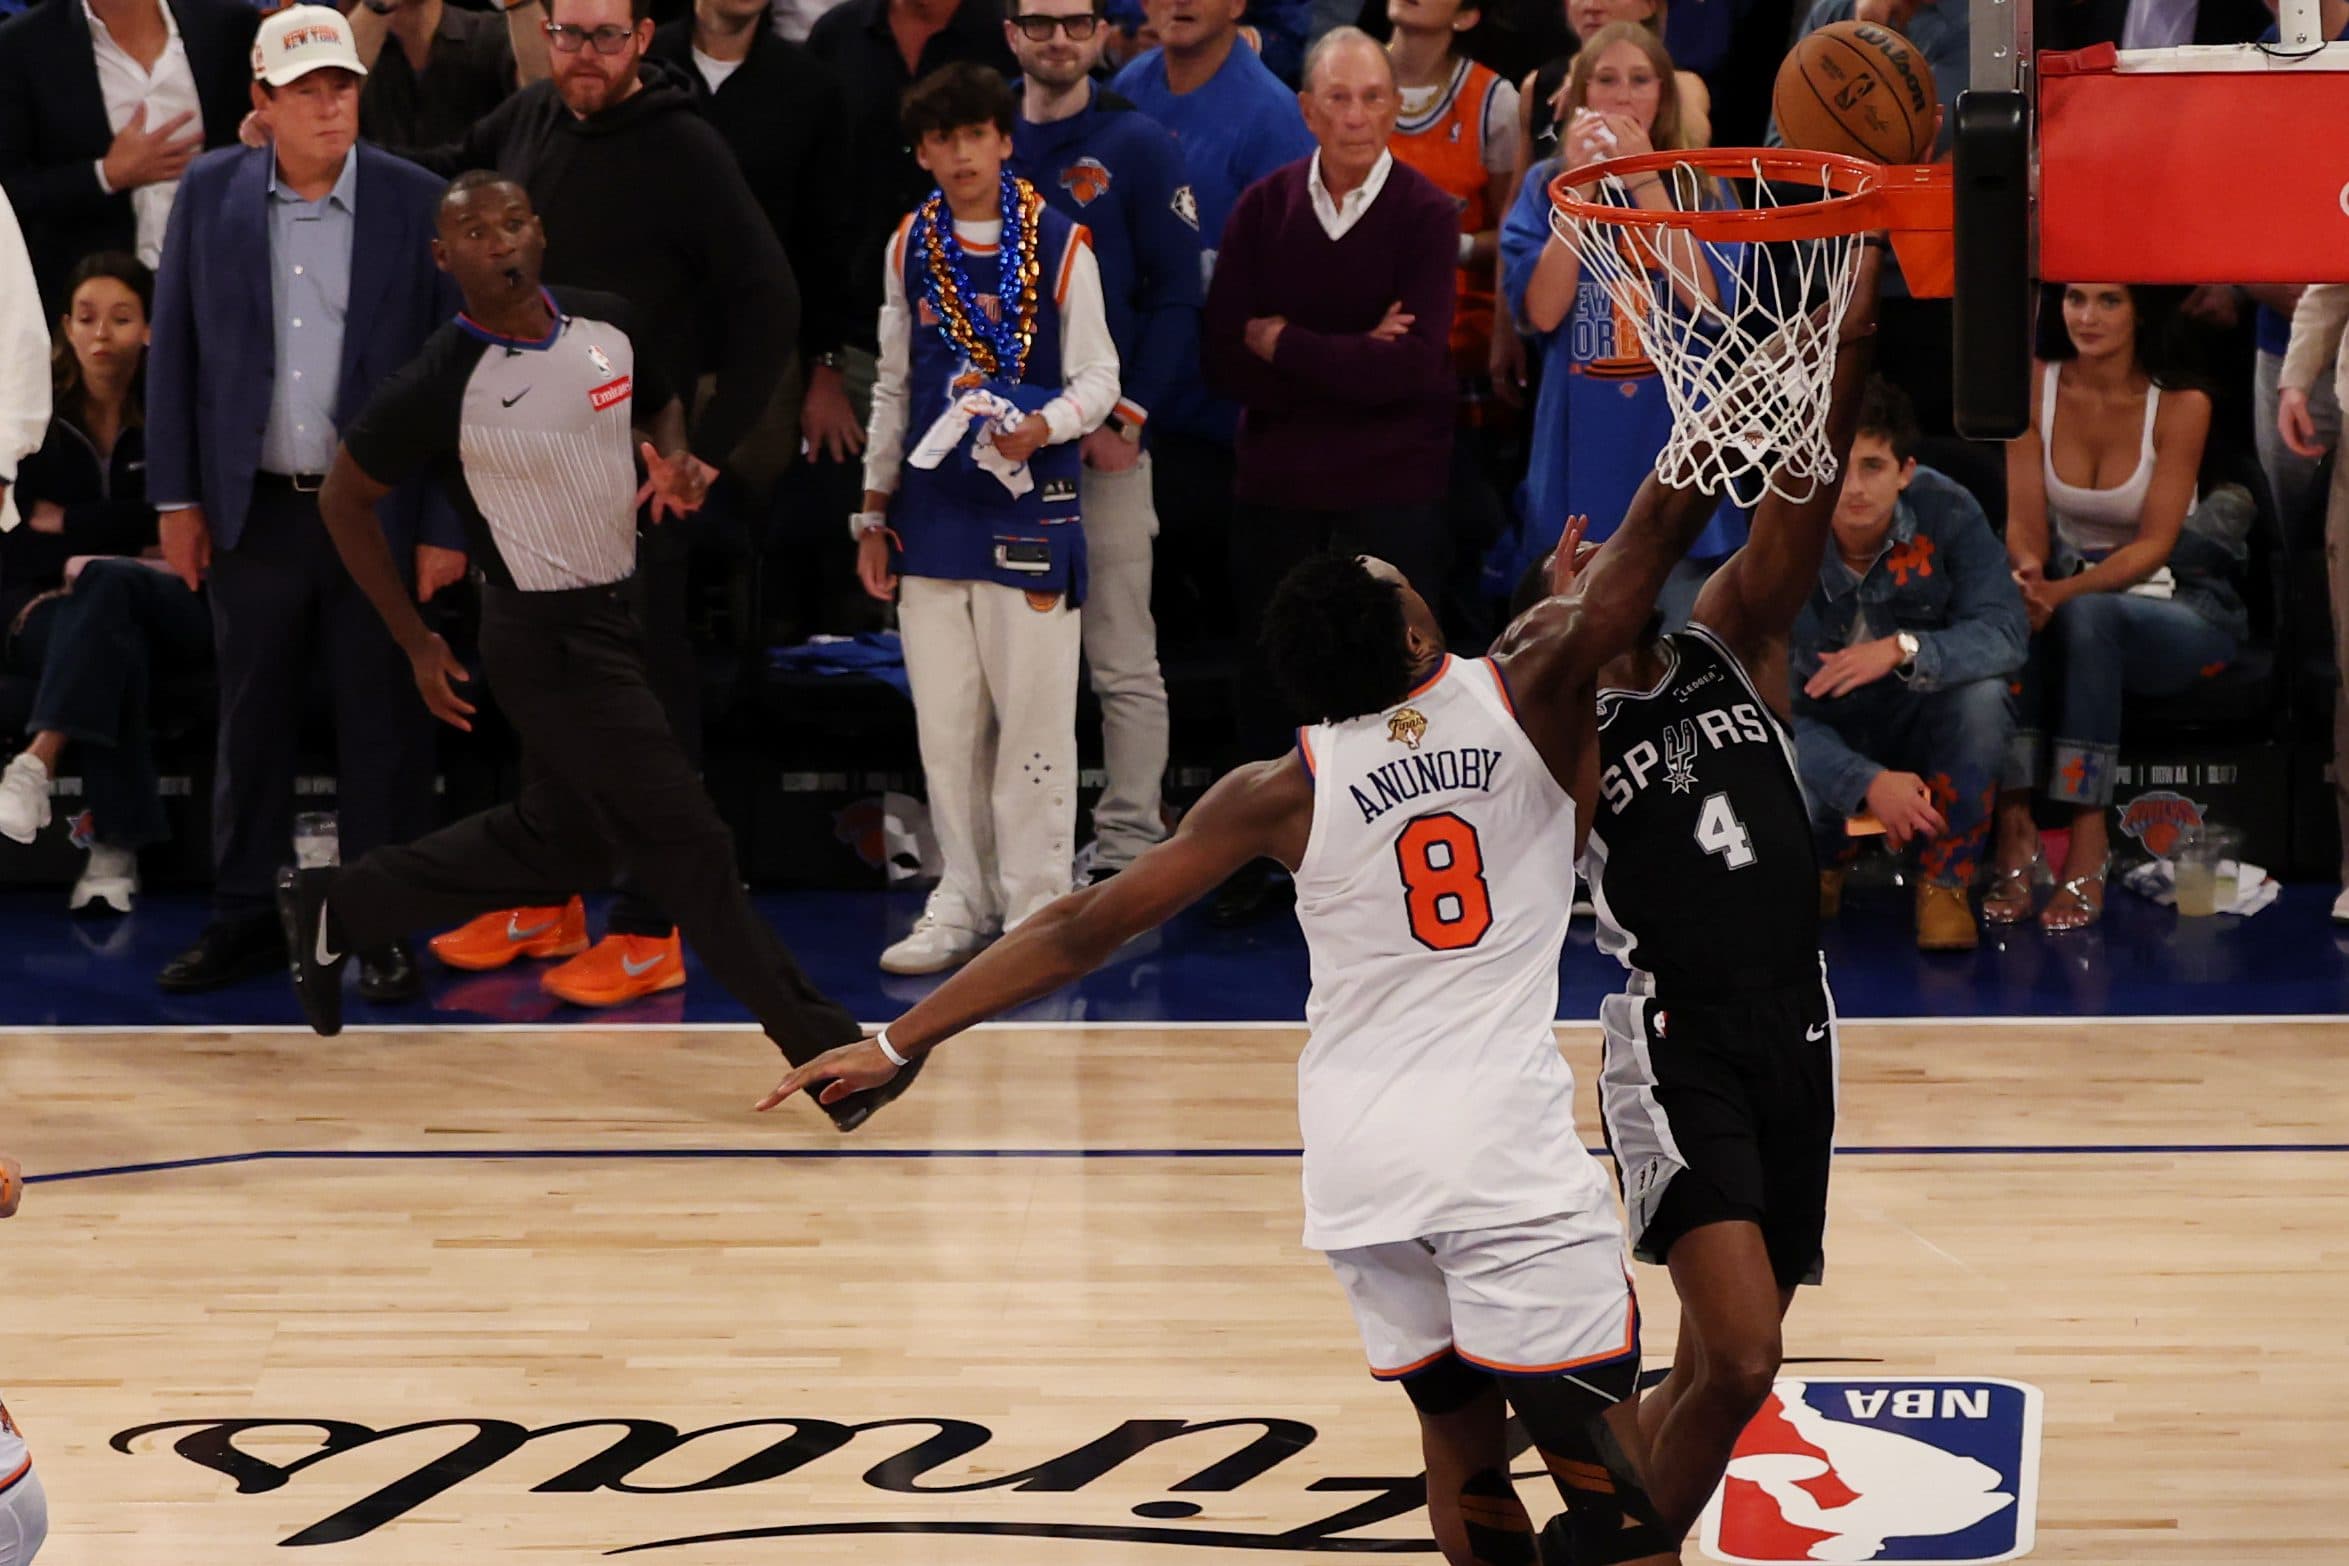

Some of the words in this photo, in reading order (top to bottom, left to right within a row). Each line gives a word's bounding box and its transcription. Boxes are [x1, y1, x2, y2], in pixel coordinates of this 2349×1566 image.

[283, 29, 307, 50] NEW
[308, 26, 342, 47] YORK
[1854, 26, 1926, 113] Wilson
[1679, 670, 1717, 697] LEDGER
[1349, 748, 1502, 825] ANUNOBY
[1599, 703, 1769, 815] SPURS
[1694, 791, 1758, 871] 4
[1394, 811, 1494, 951] 8
[1843, 1389, 1990, 1419] NBA
